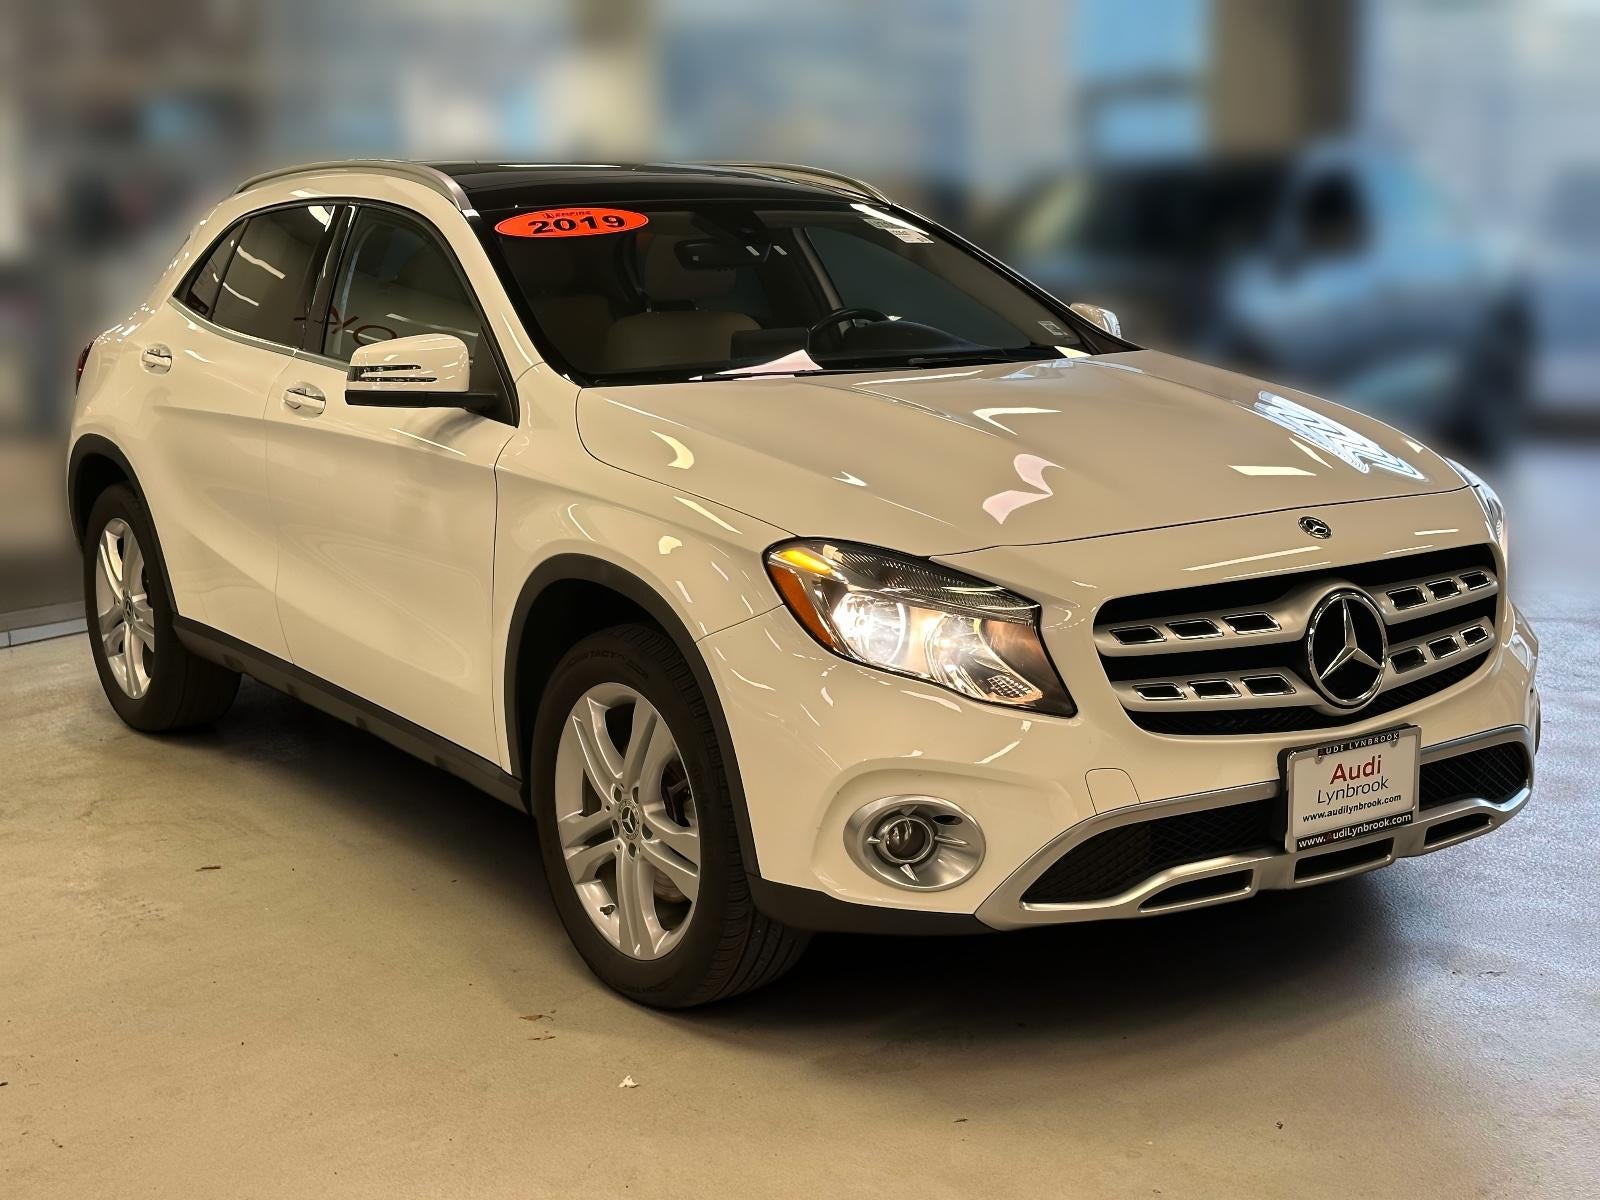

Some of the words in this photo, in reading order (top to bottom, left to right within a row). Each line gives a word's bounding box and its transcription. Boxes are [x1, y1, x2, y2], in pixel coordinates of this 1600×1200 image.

[528, 215, 625, 234] 2019
[1349, 732, 1399, 751] LYNBROOK
[1329, 754, 1382, 785] Audi
[1317, 776, 1389, 805] Lynbrook
[1302, 794, 1402, 822] www.audilynbrook.com
